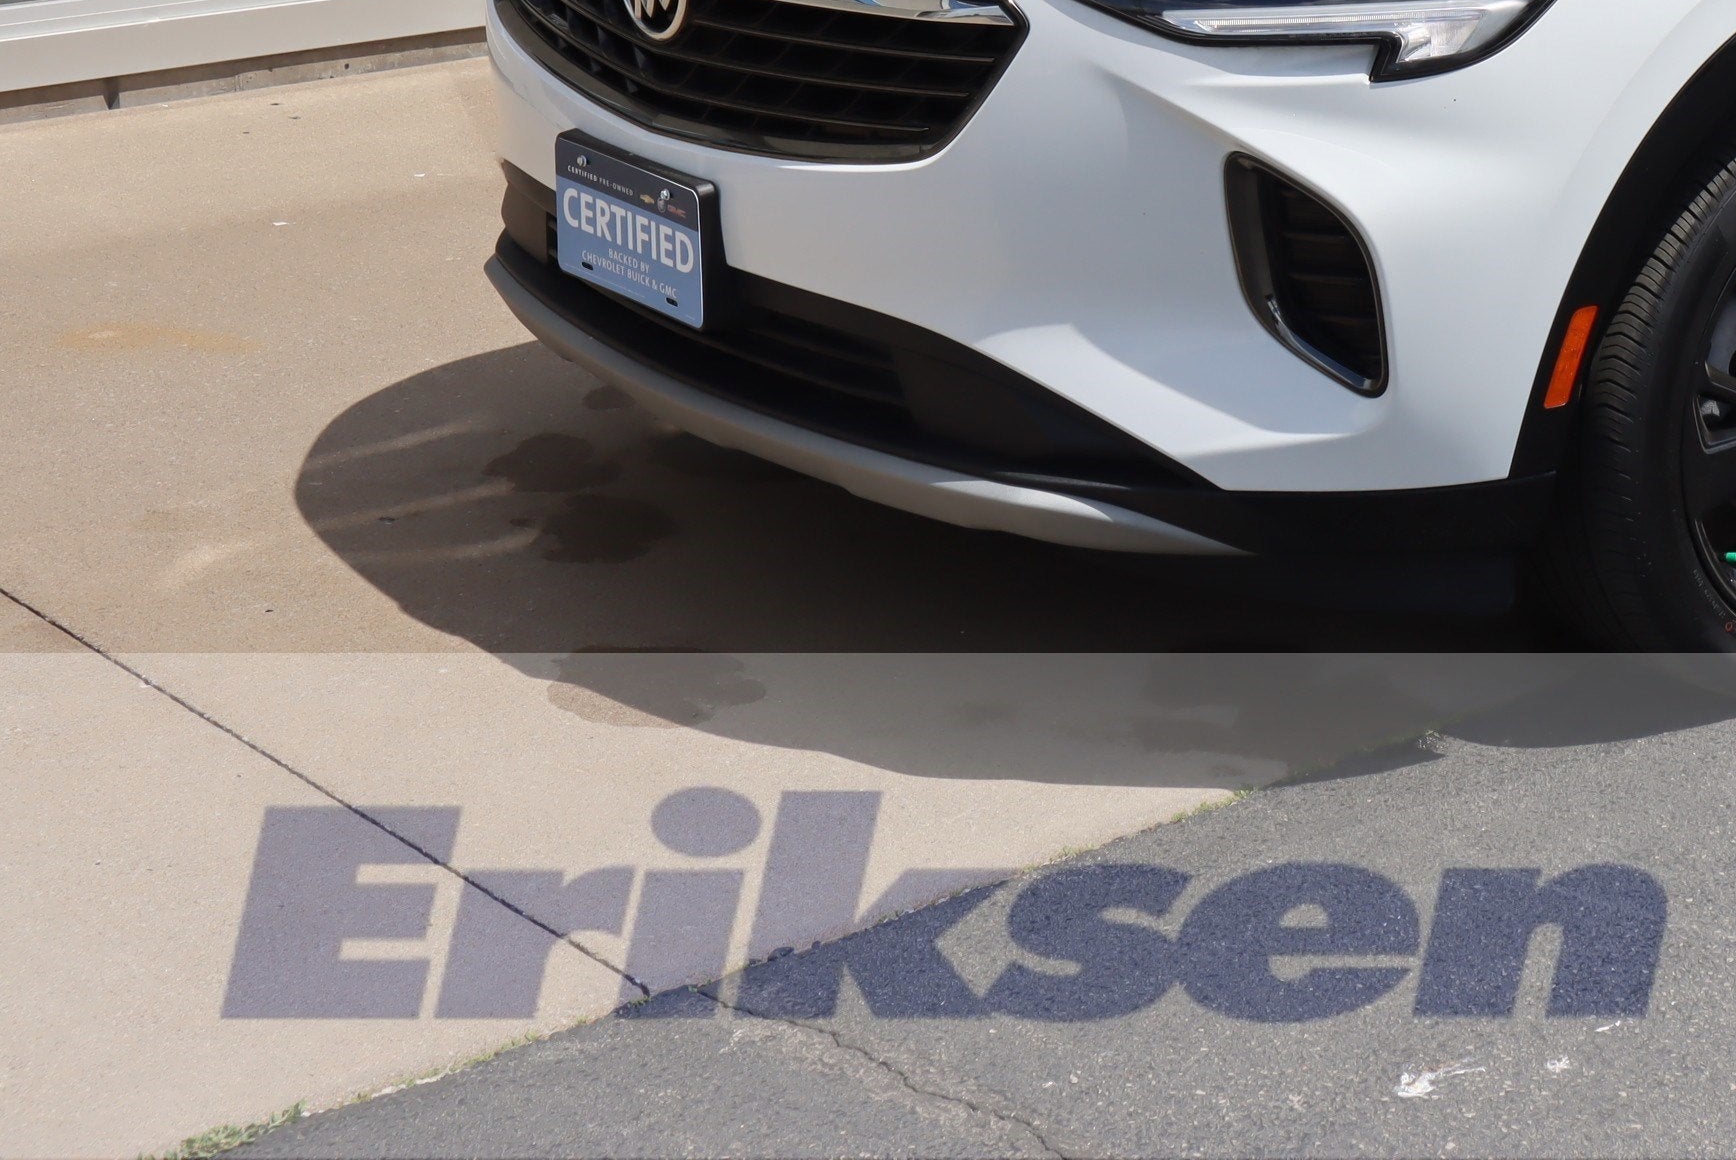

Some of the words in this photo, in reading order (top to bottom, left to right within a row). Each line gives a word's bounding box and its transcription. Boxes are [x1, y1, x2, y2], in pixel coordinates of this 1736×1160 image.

[567, 165, 598, 182] CERTIFIED
[599, 177, 634, 196] PRE-OWNED
[563, 188, 694, 273] CERTIFIED
[581, 250, 625, 275] CHEVROLET
[627, 268, 650, 287] BUICK
[651, 280, 658, 291] &
[659, 283, 677, 299] GMC
[608, 248, 638, 269] BACKED
[640, 261, 650, 274] BY
